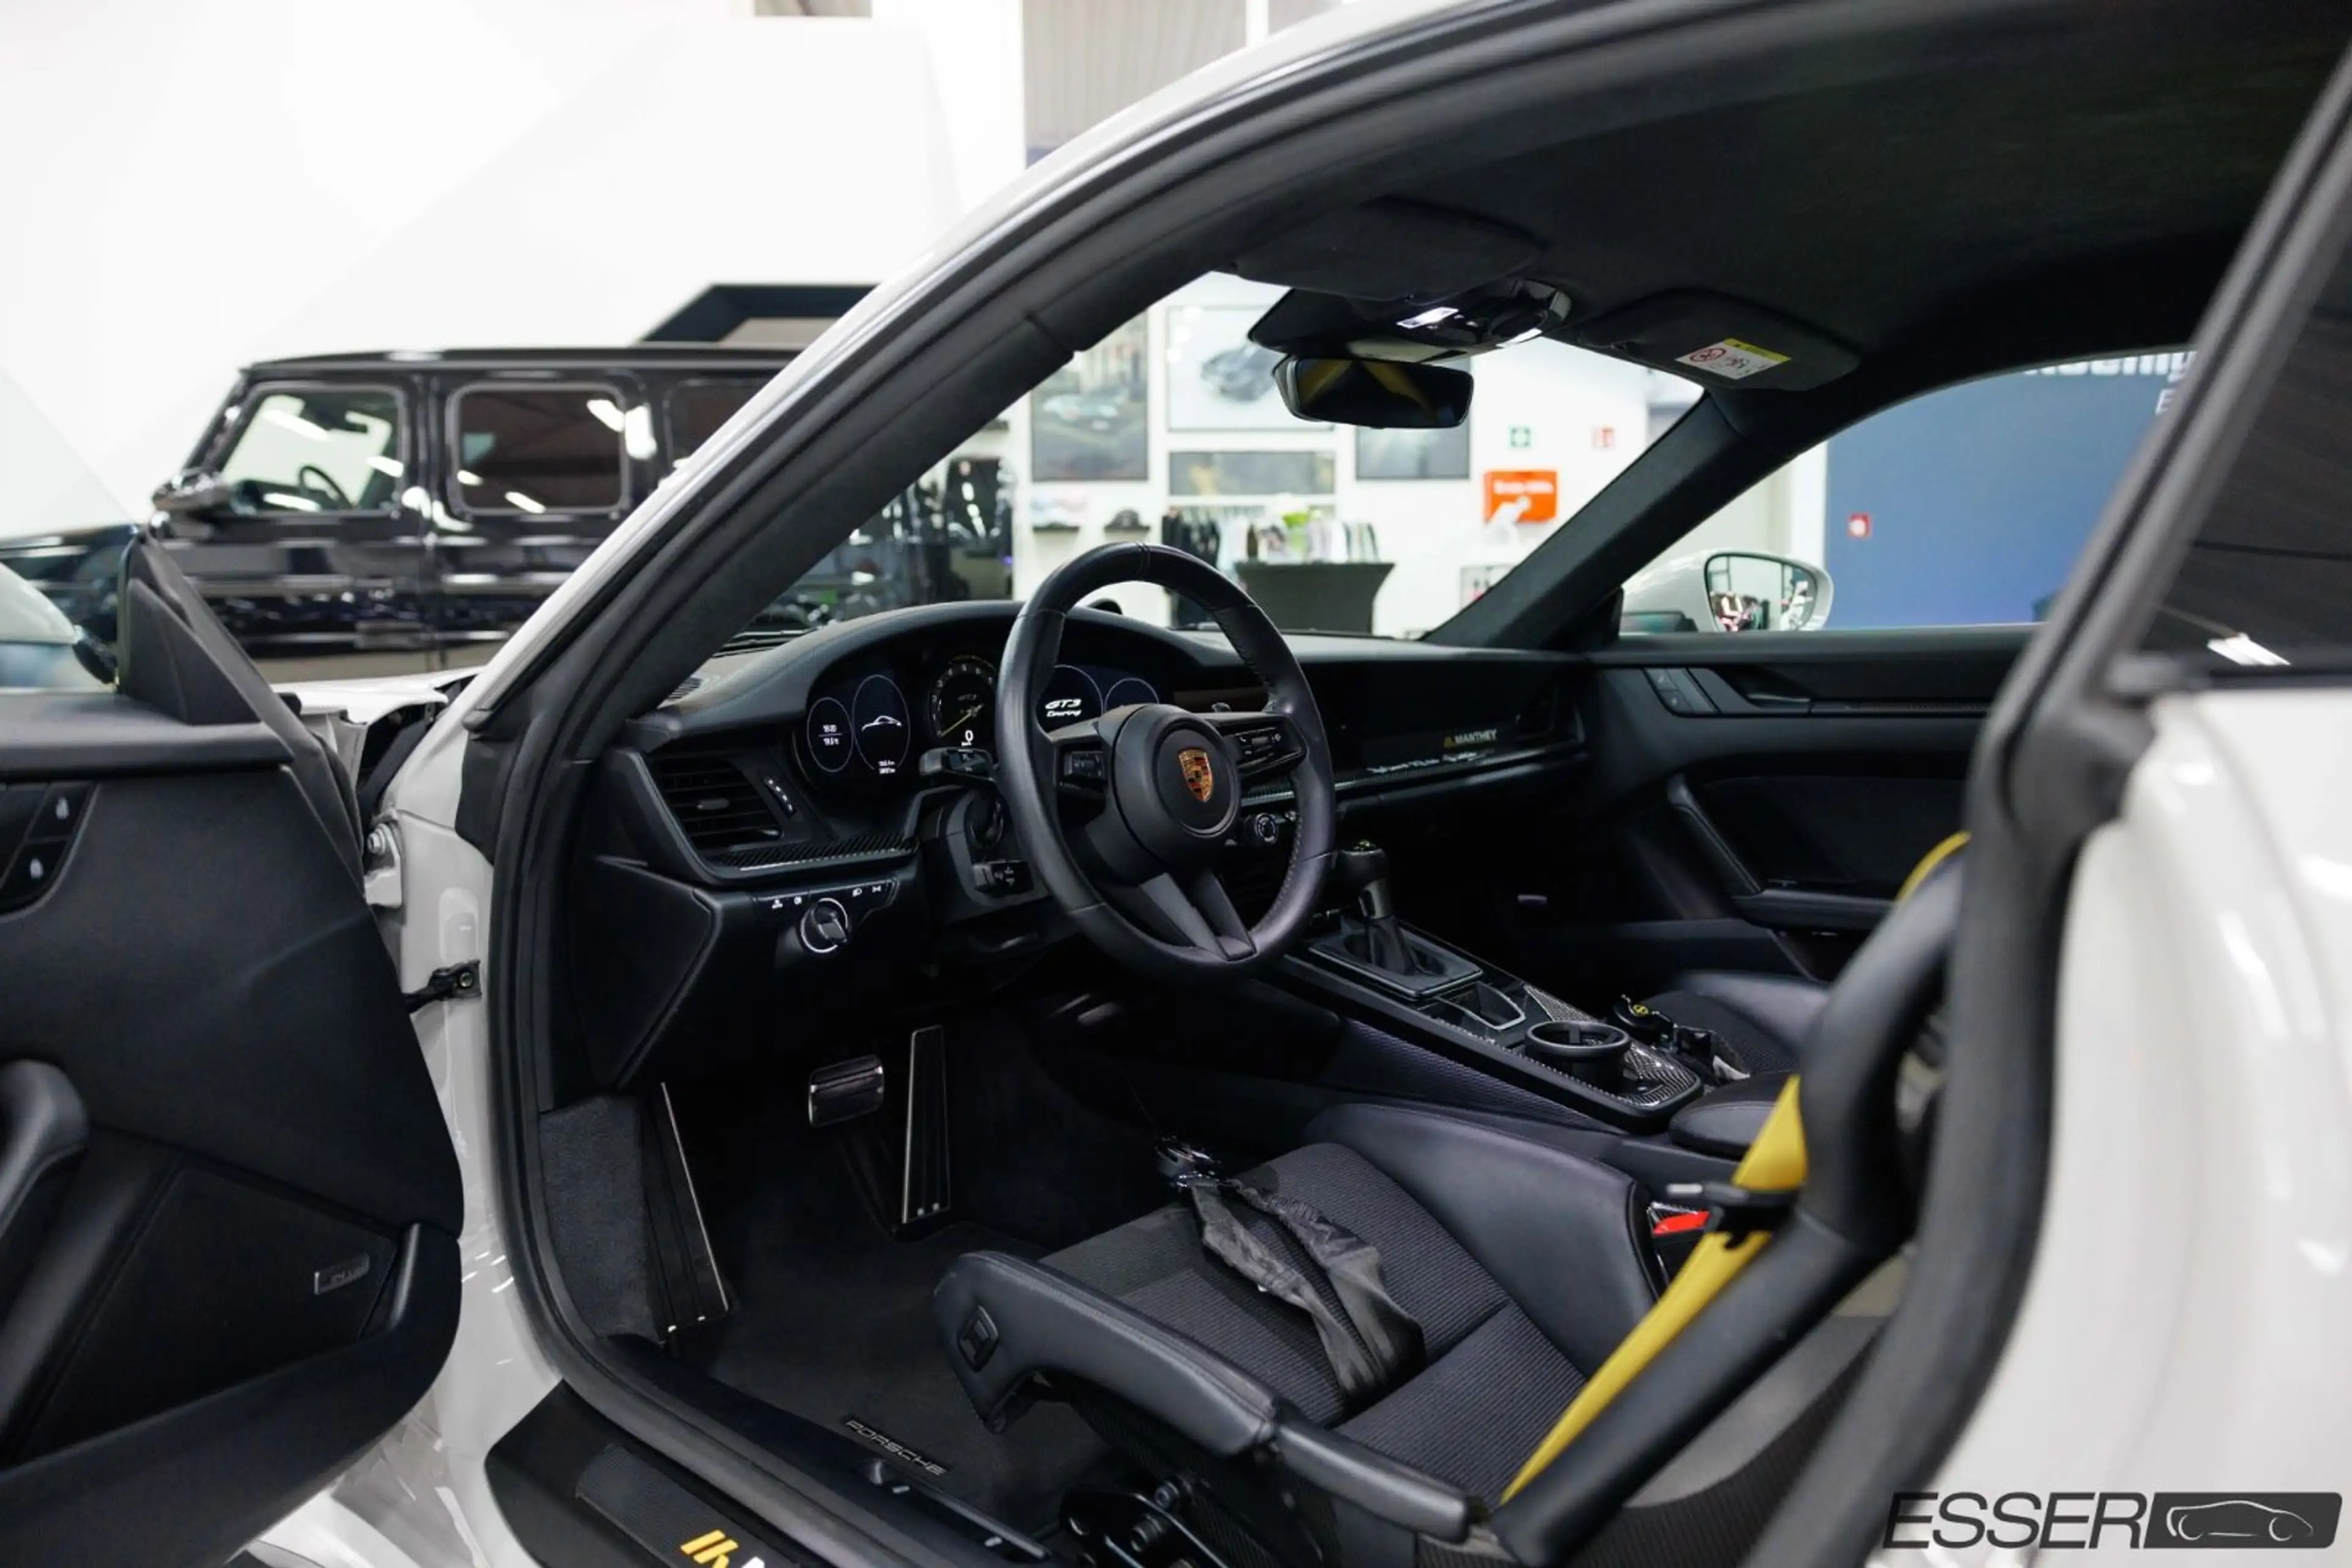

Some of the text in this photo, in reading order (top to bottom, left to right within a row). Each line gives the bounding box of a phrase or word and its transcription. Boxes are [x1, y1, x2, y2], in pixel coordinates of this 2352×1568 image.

[1045, 699, 1082, 709] GT3
[965, 729, 974, 742] 0
[1455, 729, 1497, 745] MANTHEY
[845, 1420, 948, 1476] PORSCHE
